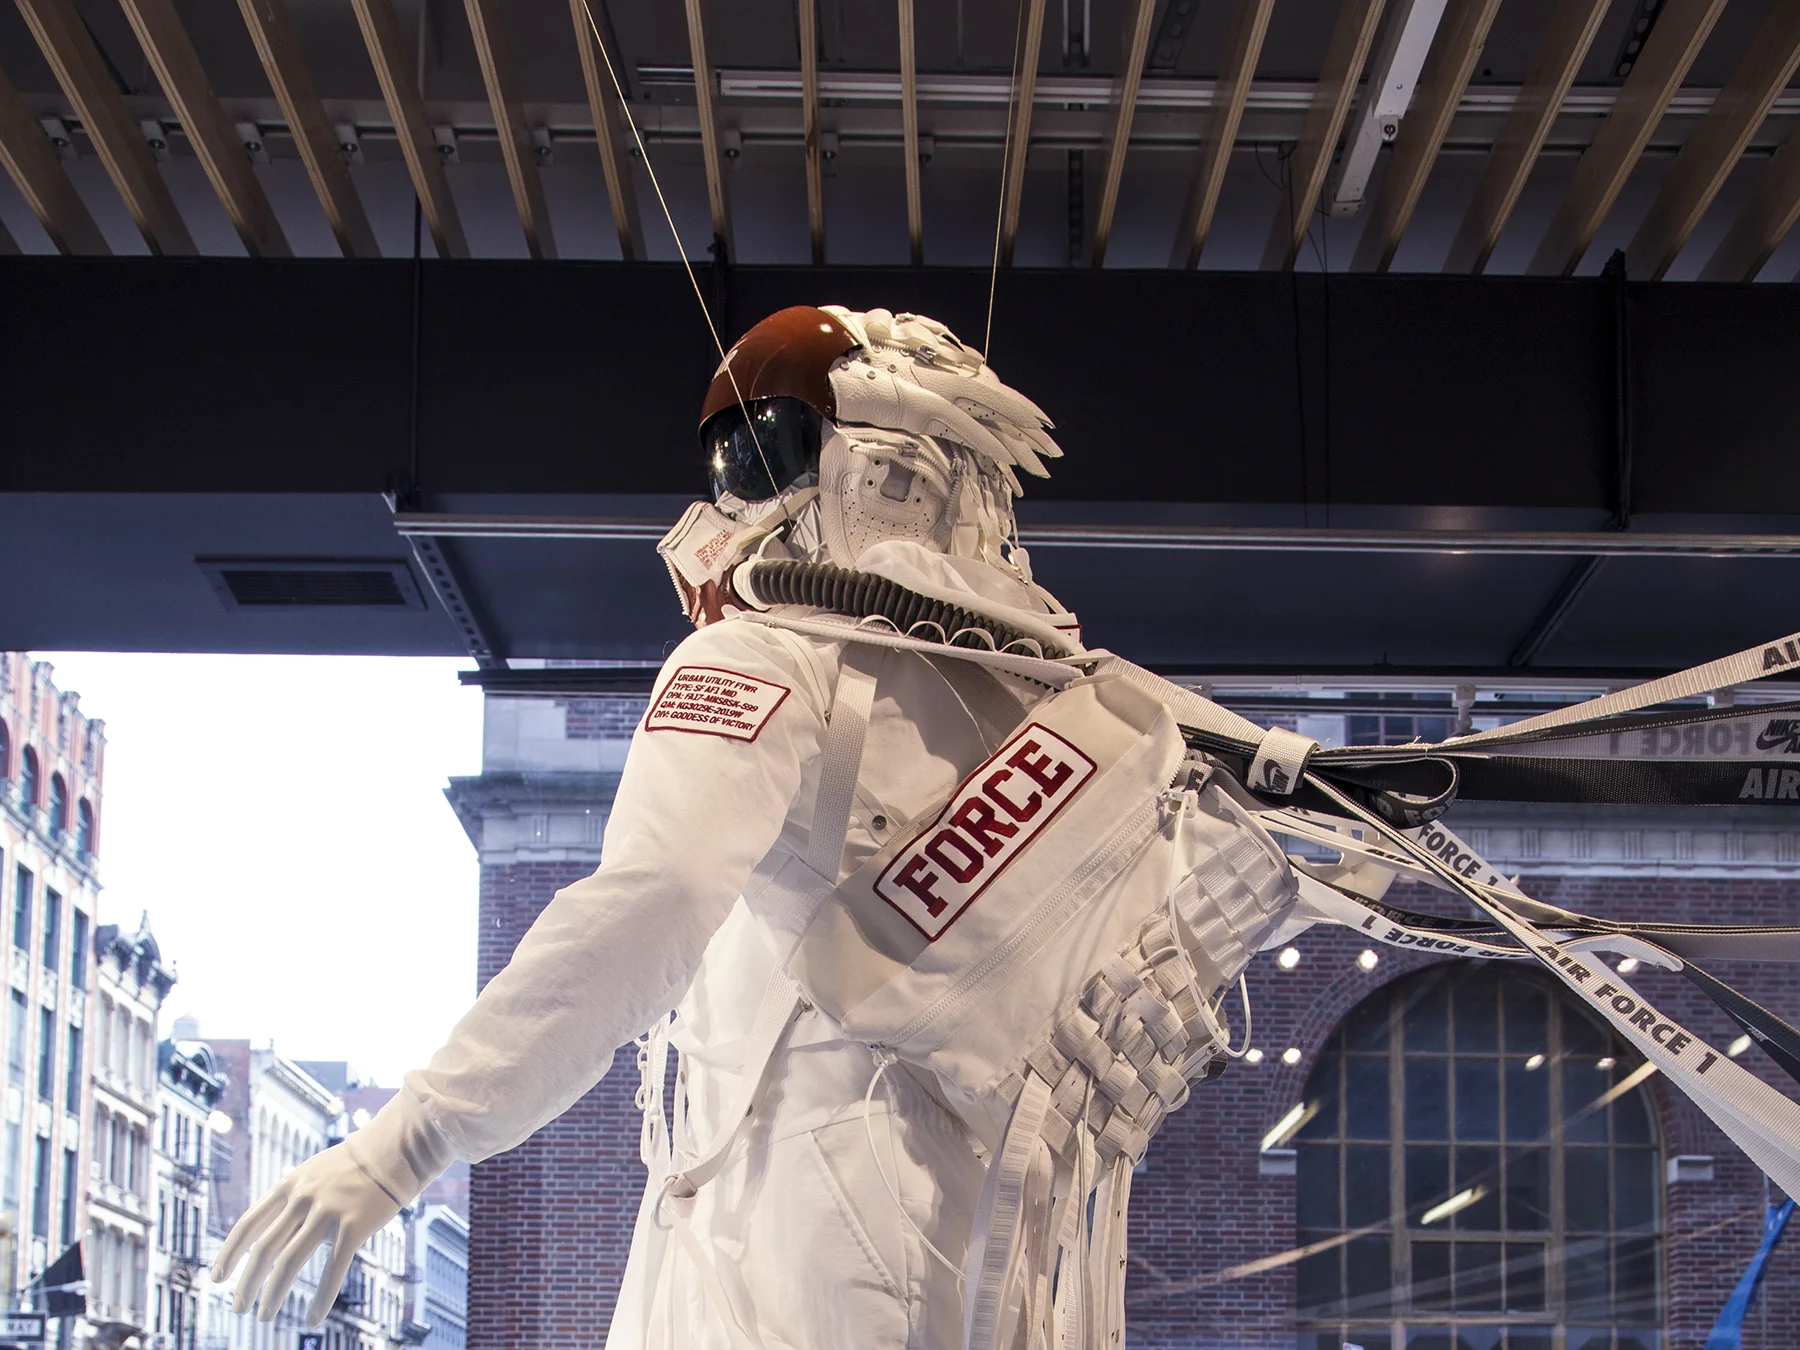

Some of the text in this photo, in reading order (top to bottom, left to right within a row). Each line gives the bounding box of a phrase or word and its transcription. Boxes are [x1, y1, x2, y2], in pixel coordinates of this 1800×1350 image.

[1763, 637, 1800, 671] AI
[678, 674, 758, 693] URBAN UTILITY FTWR
[704, 686, 720, 694] AF1
[720, 689, 738, 698] MID
[670, 711, 710, 723] GODDESS
[709, 716, 722, 724] OF
[721, 718, 756, 731] VICTORY
[1739, 767, 1800, 800] AIR
[892, 739, 1075, 919] FORCE
[1418, 822, 1482, 880] FORCE
[1383, 927, 1470, 953] FORCE
[1537, 945, 1719, 1075] AIR FORCE 1
